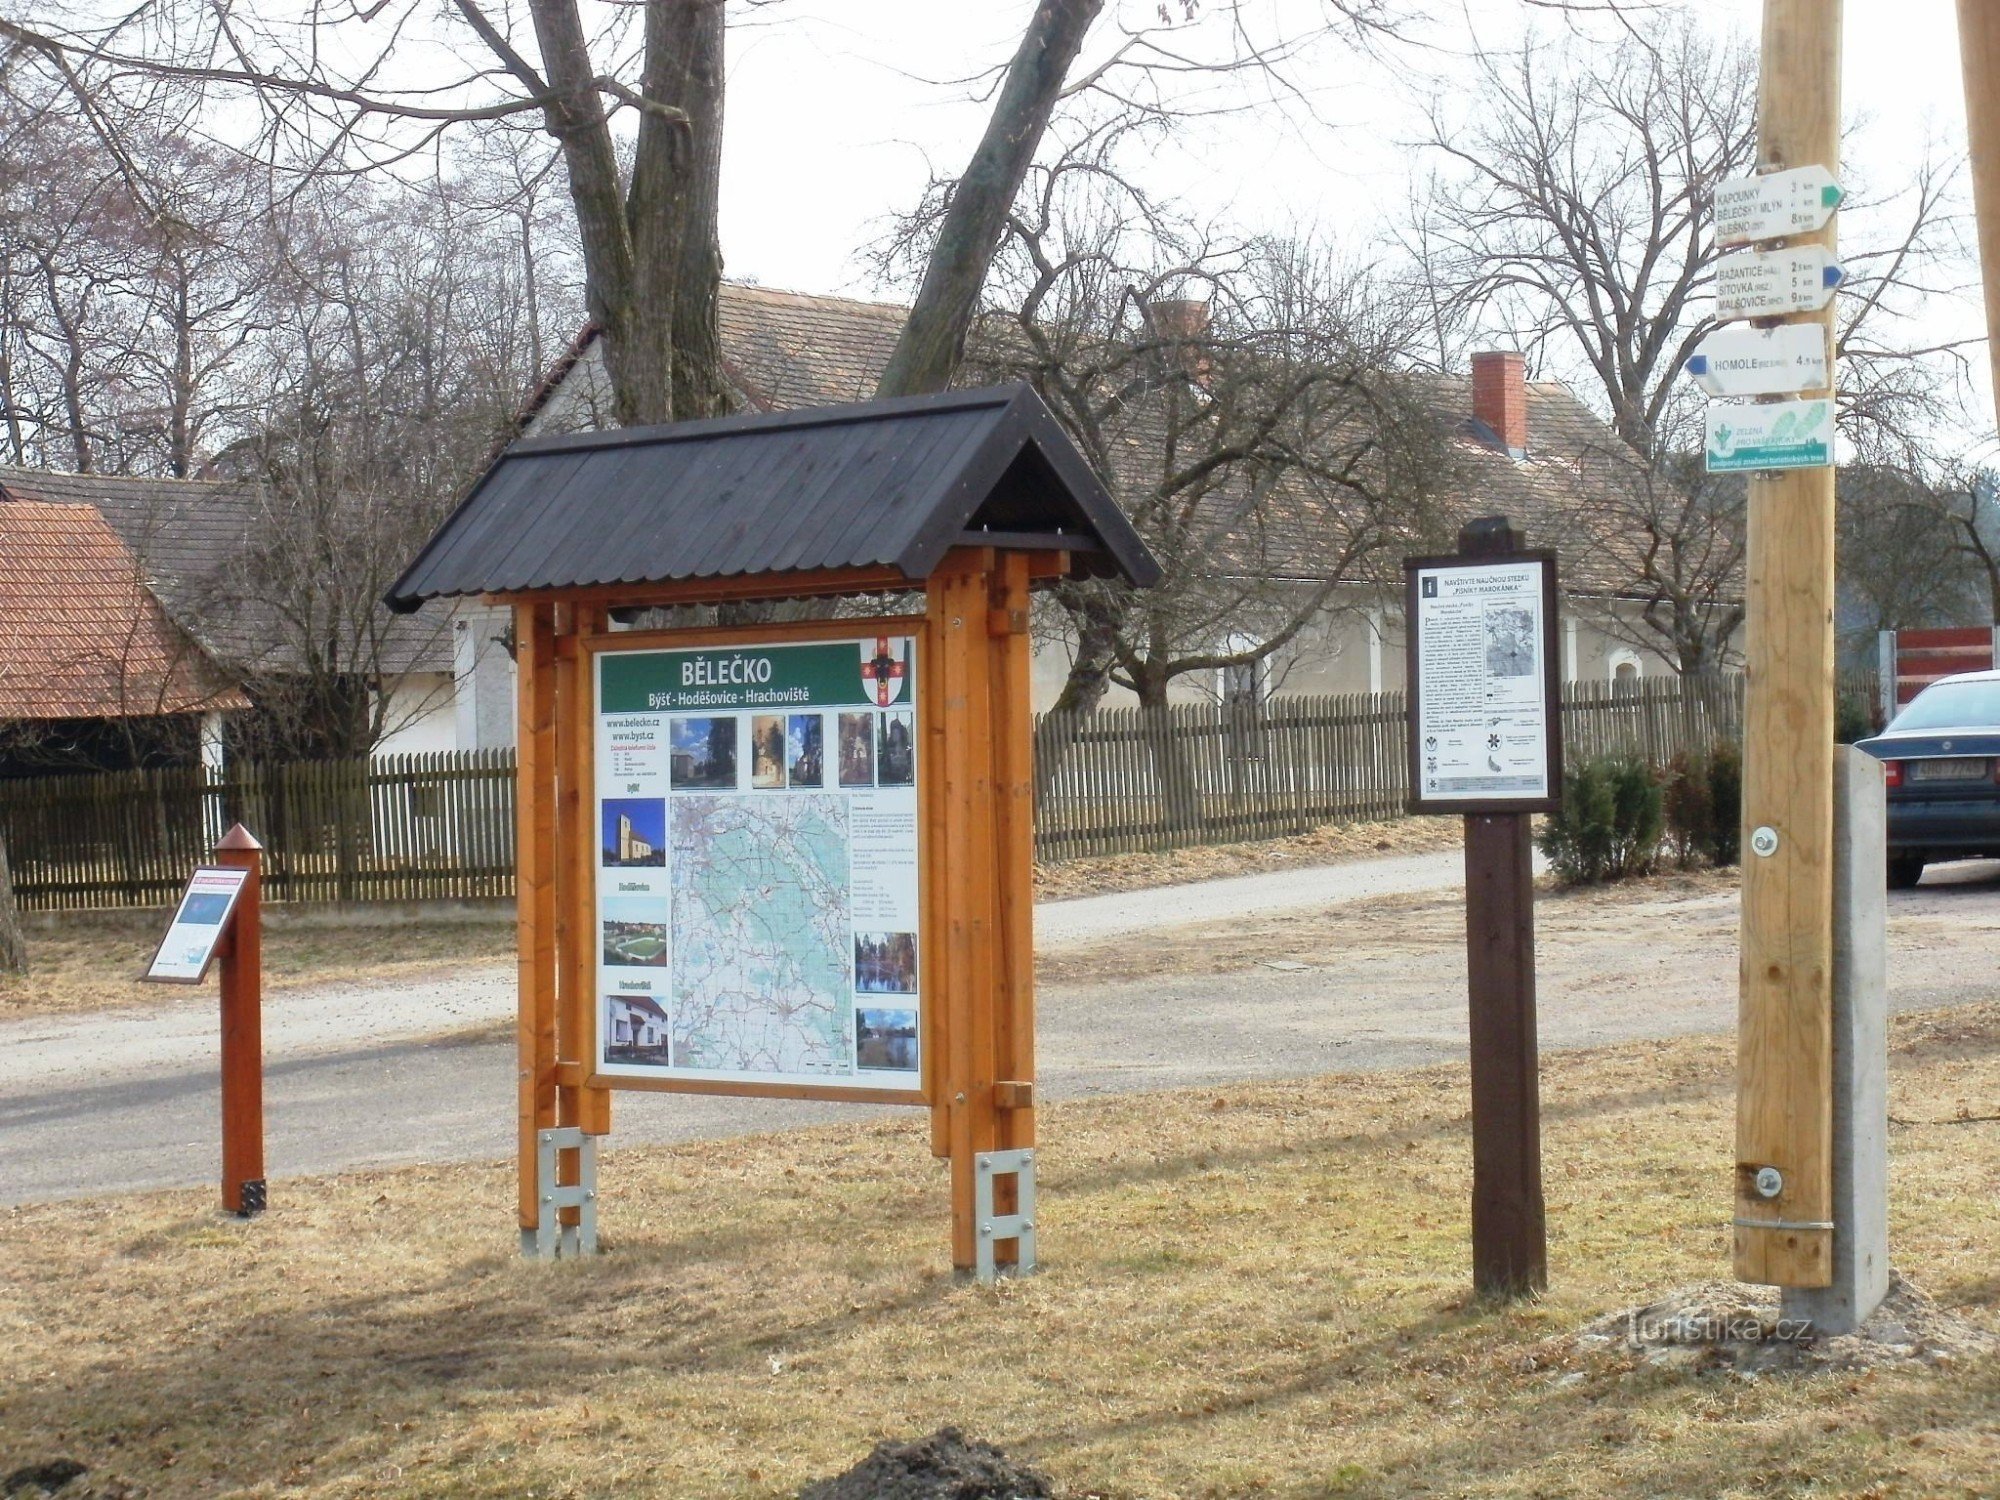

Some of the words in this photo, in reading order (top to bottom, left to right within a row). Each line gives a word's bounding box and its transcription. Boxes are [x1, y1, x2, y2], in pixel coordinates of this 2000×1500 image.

[1717, 188, 1760, 206] KAPOUNKY
[1719, 266, 1763, 281] BAŽANTICE
[1791, 277, 1798, 288] 5
[1718, 296, 1767, 311] MALŠOVICE
[1715, 358, 1758, 371] HOMOLE
[1444, 578, 1475, 586] NAVŠTIVTE
[682, 654, 771, 686] BĚLEČKO
[648, 690, 672, 710] Býšť
[678, 688, 738, 705] Hoděšovice
[746, 686, 810, 703] Hrachoviště
[606, 717, 660, 728] www.belecko.cz
[612, 731, 654, 742] www.byst.cz
